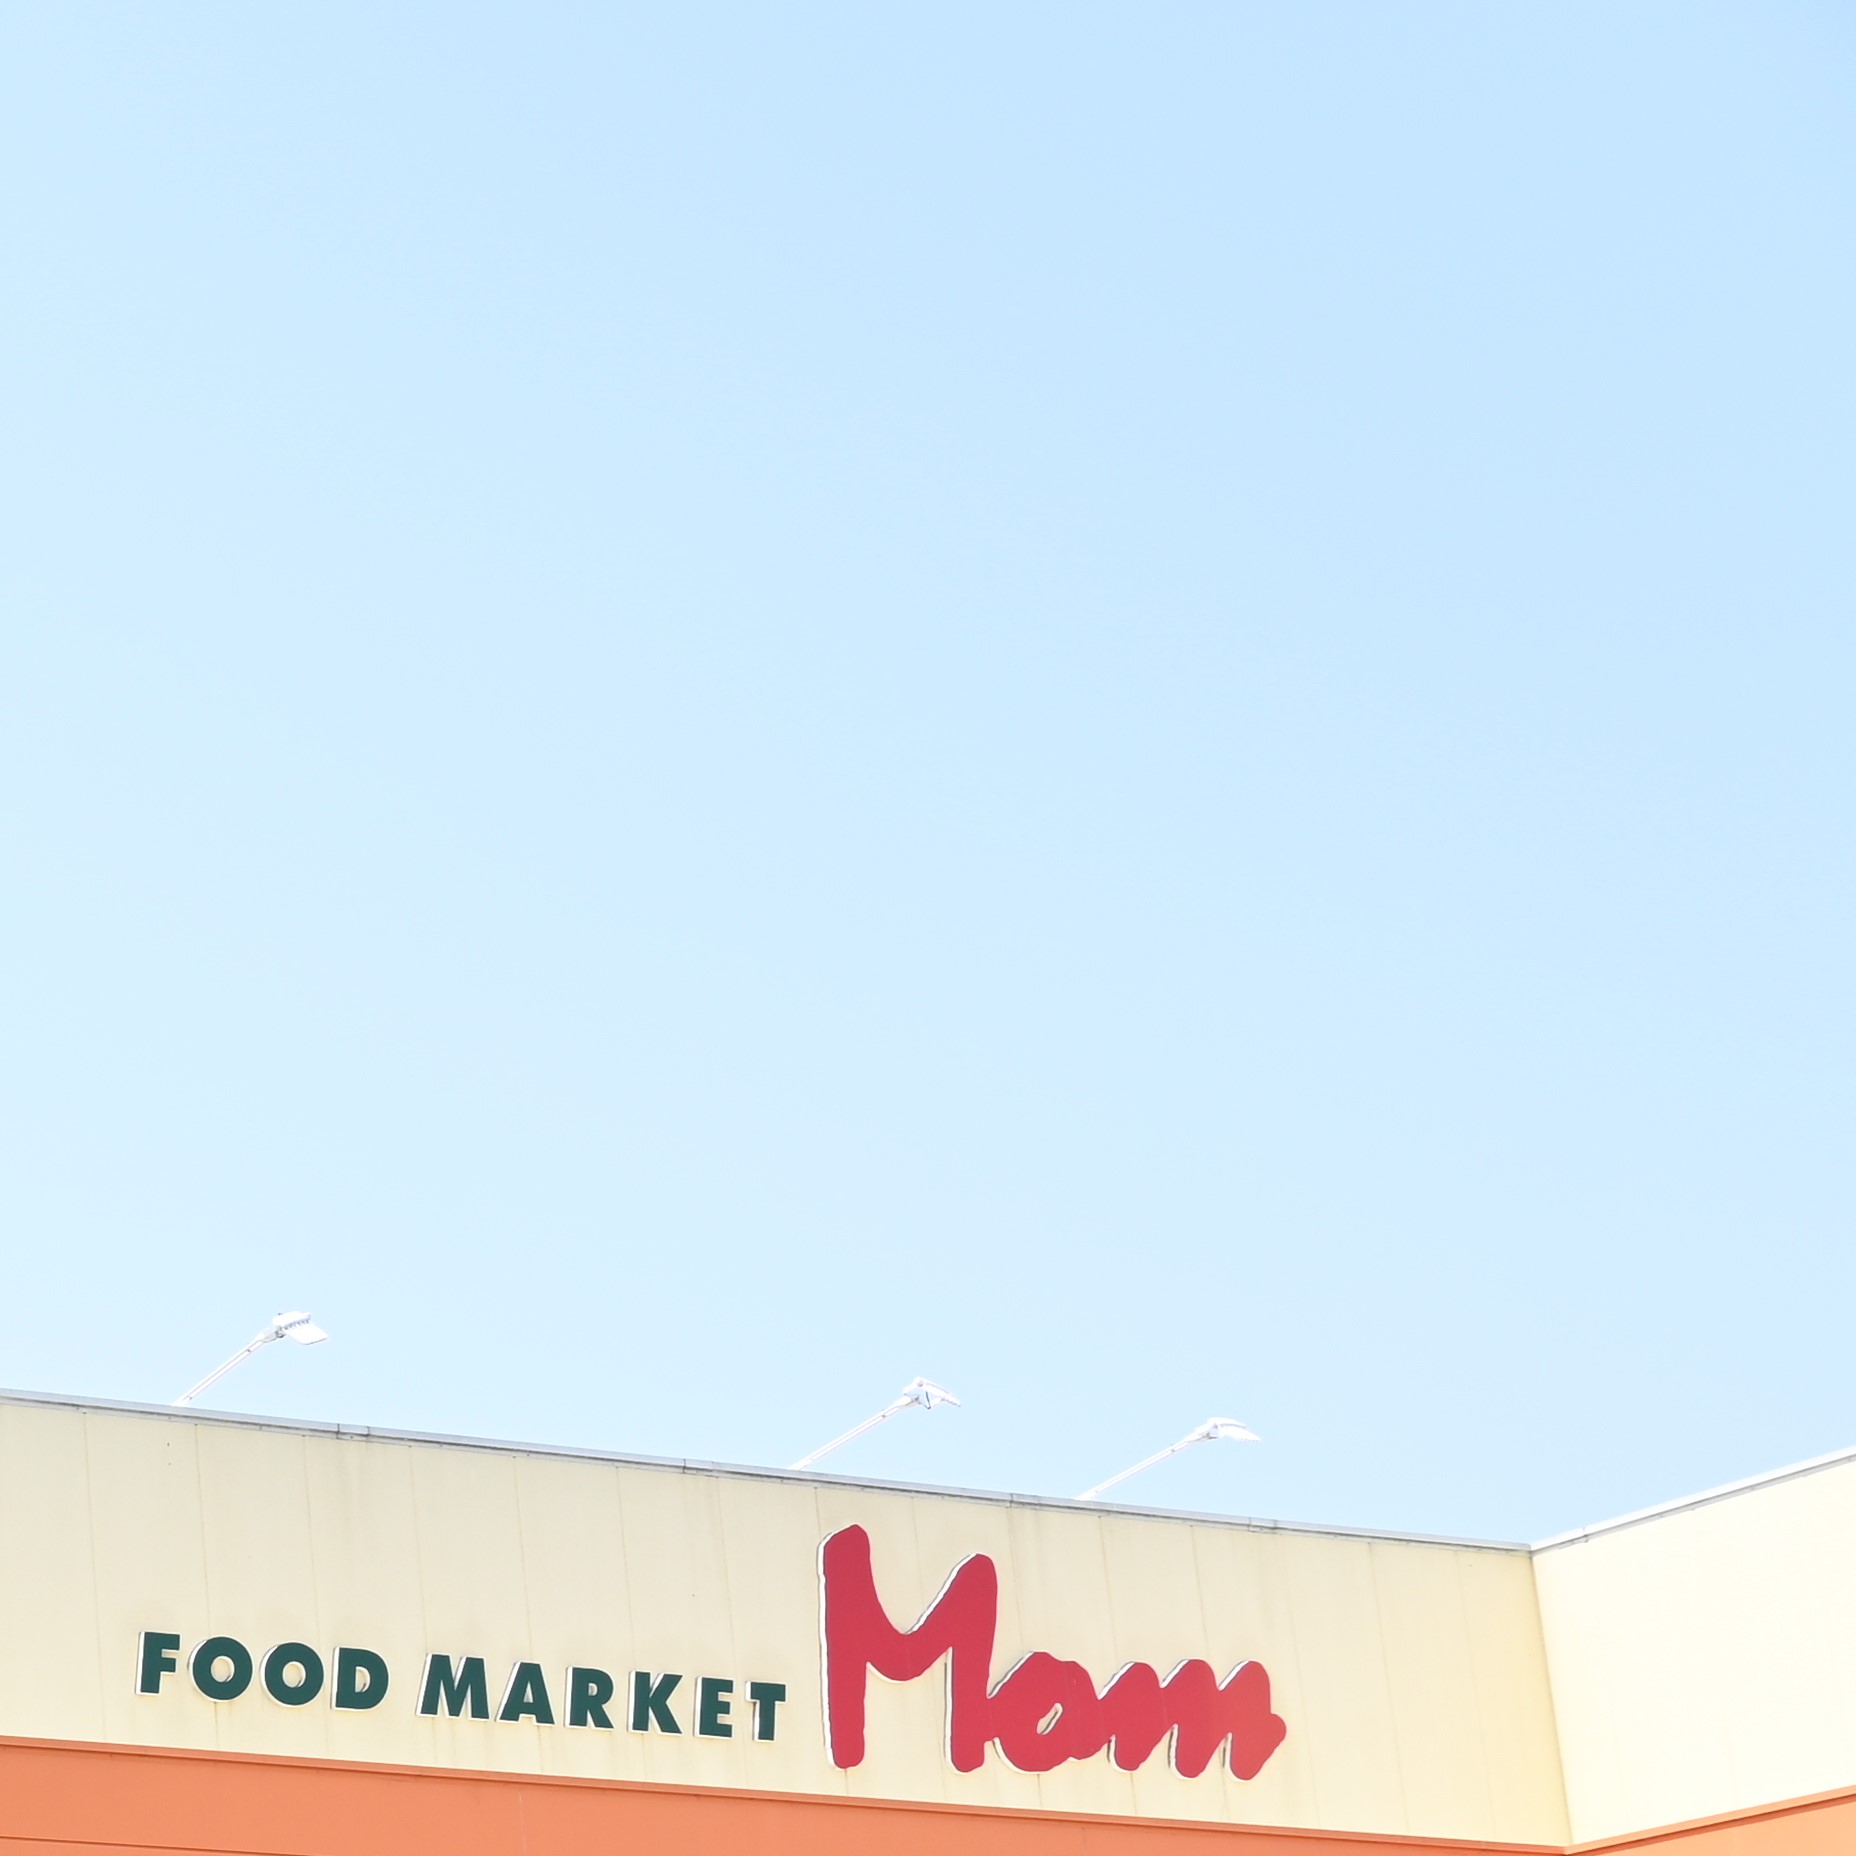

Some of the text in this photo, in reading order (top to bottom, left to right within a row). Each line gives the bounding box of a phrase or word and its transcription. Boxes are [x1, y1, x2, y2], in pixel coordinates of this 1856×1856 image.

[135, 1631, 788, 1743] FOOD MARKET
[817, 1523, 1288, 1782] Mom
